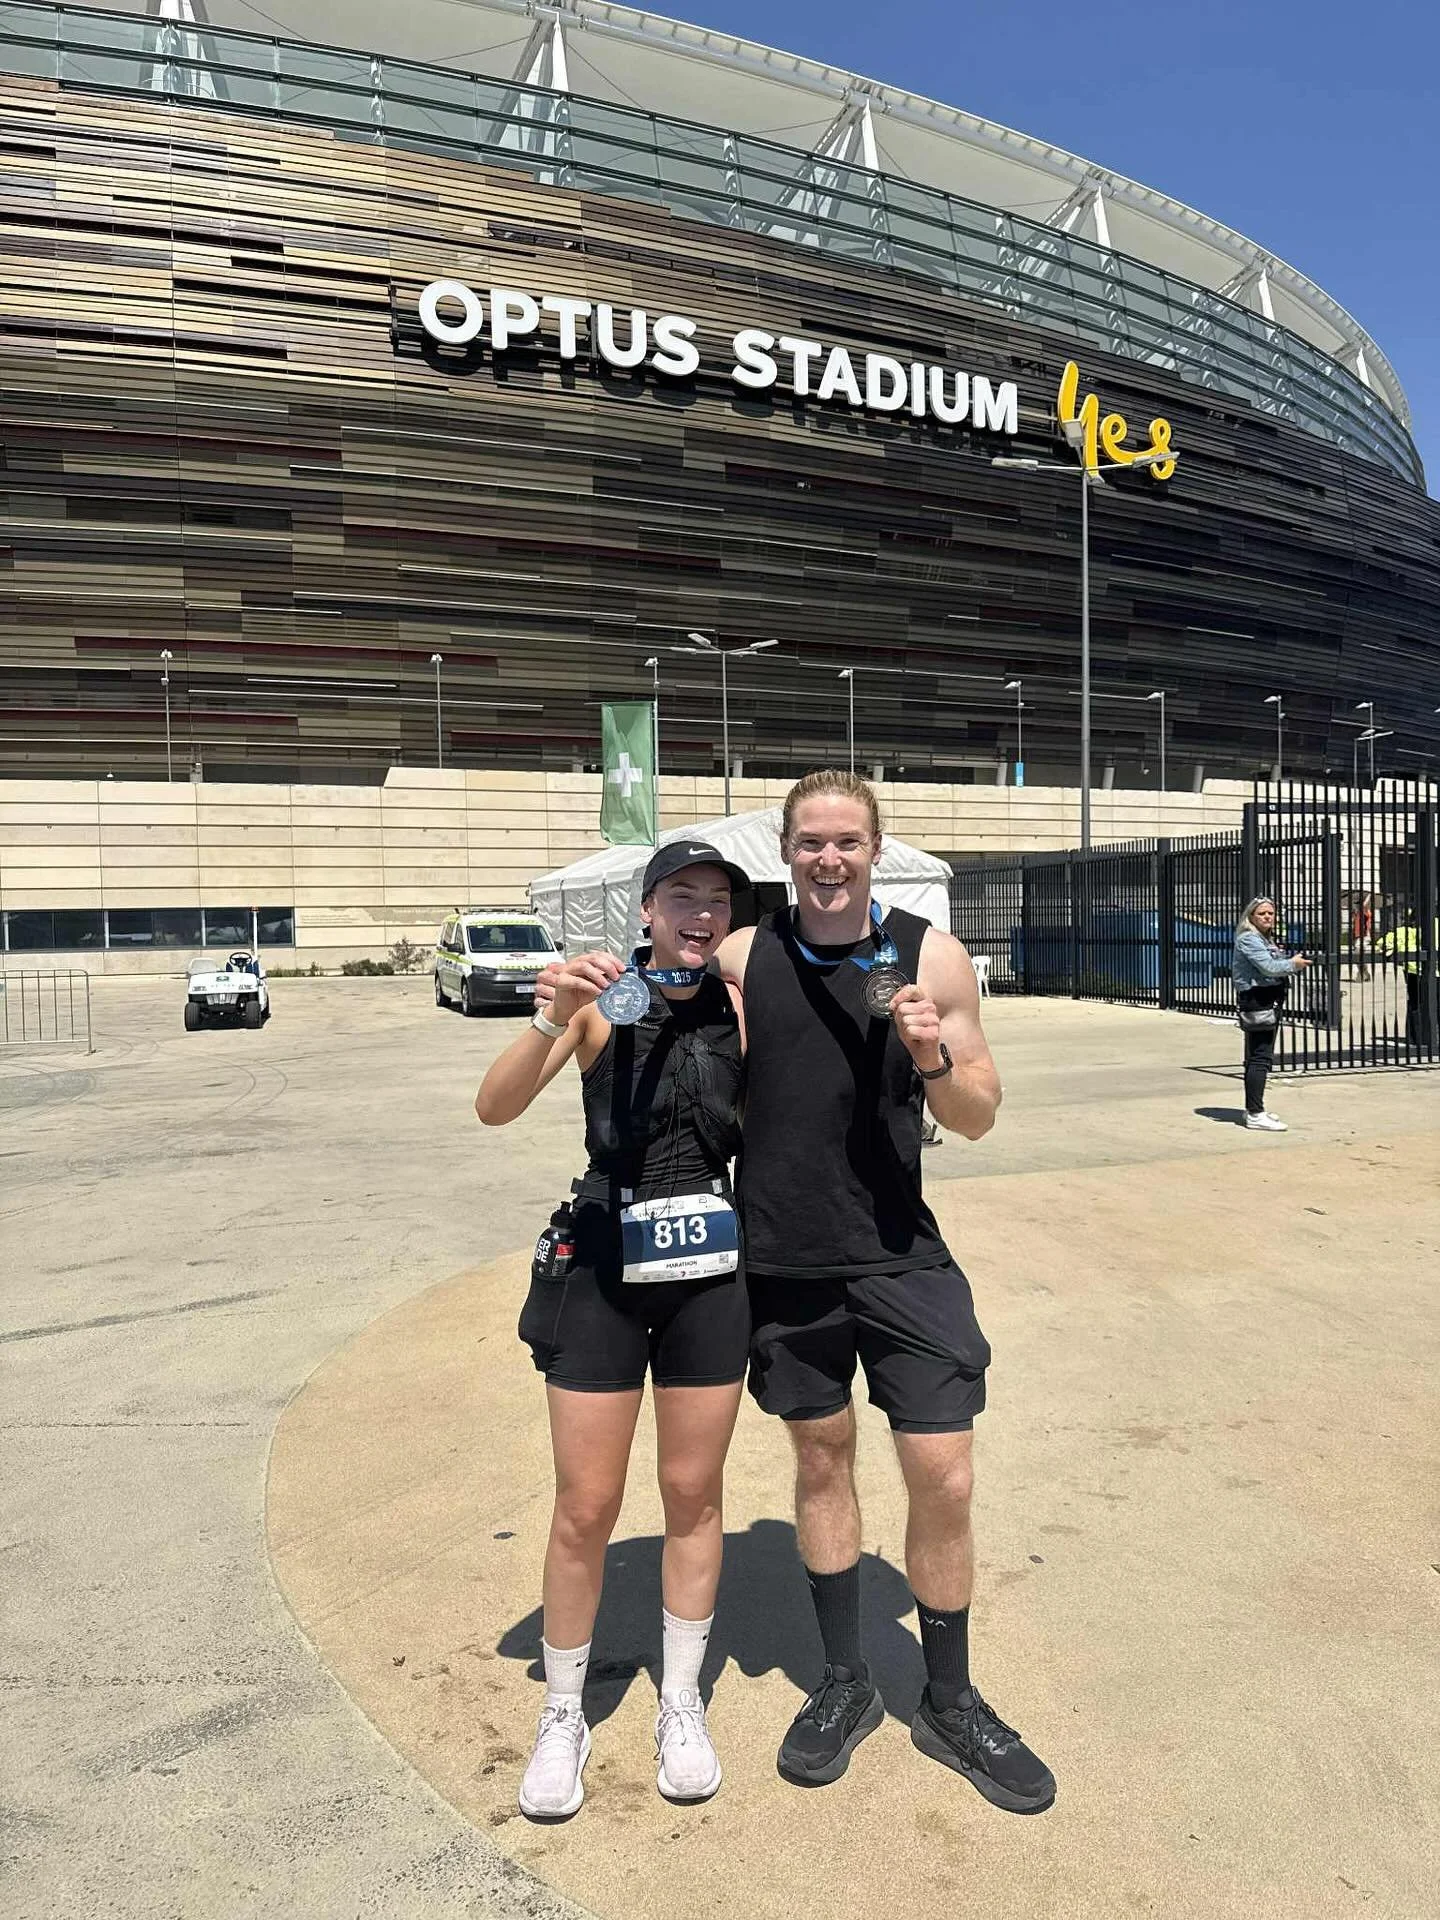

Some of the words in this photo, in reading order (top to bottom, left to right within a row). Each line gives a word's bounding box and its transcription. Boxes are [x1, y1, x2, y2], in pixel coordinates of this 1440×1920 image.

[418, 279, 700, 376] OPTUS
[731, 329, 1018, 435] STADIUM
[671, 971, 691, 984] 2025
[654, 1215, 708, 1249] 813
[666, 1260, 698, 1269] MARATHON
